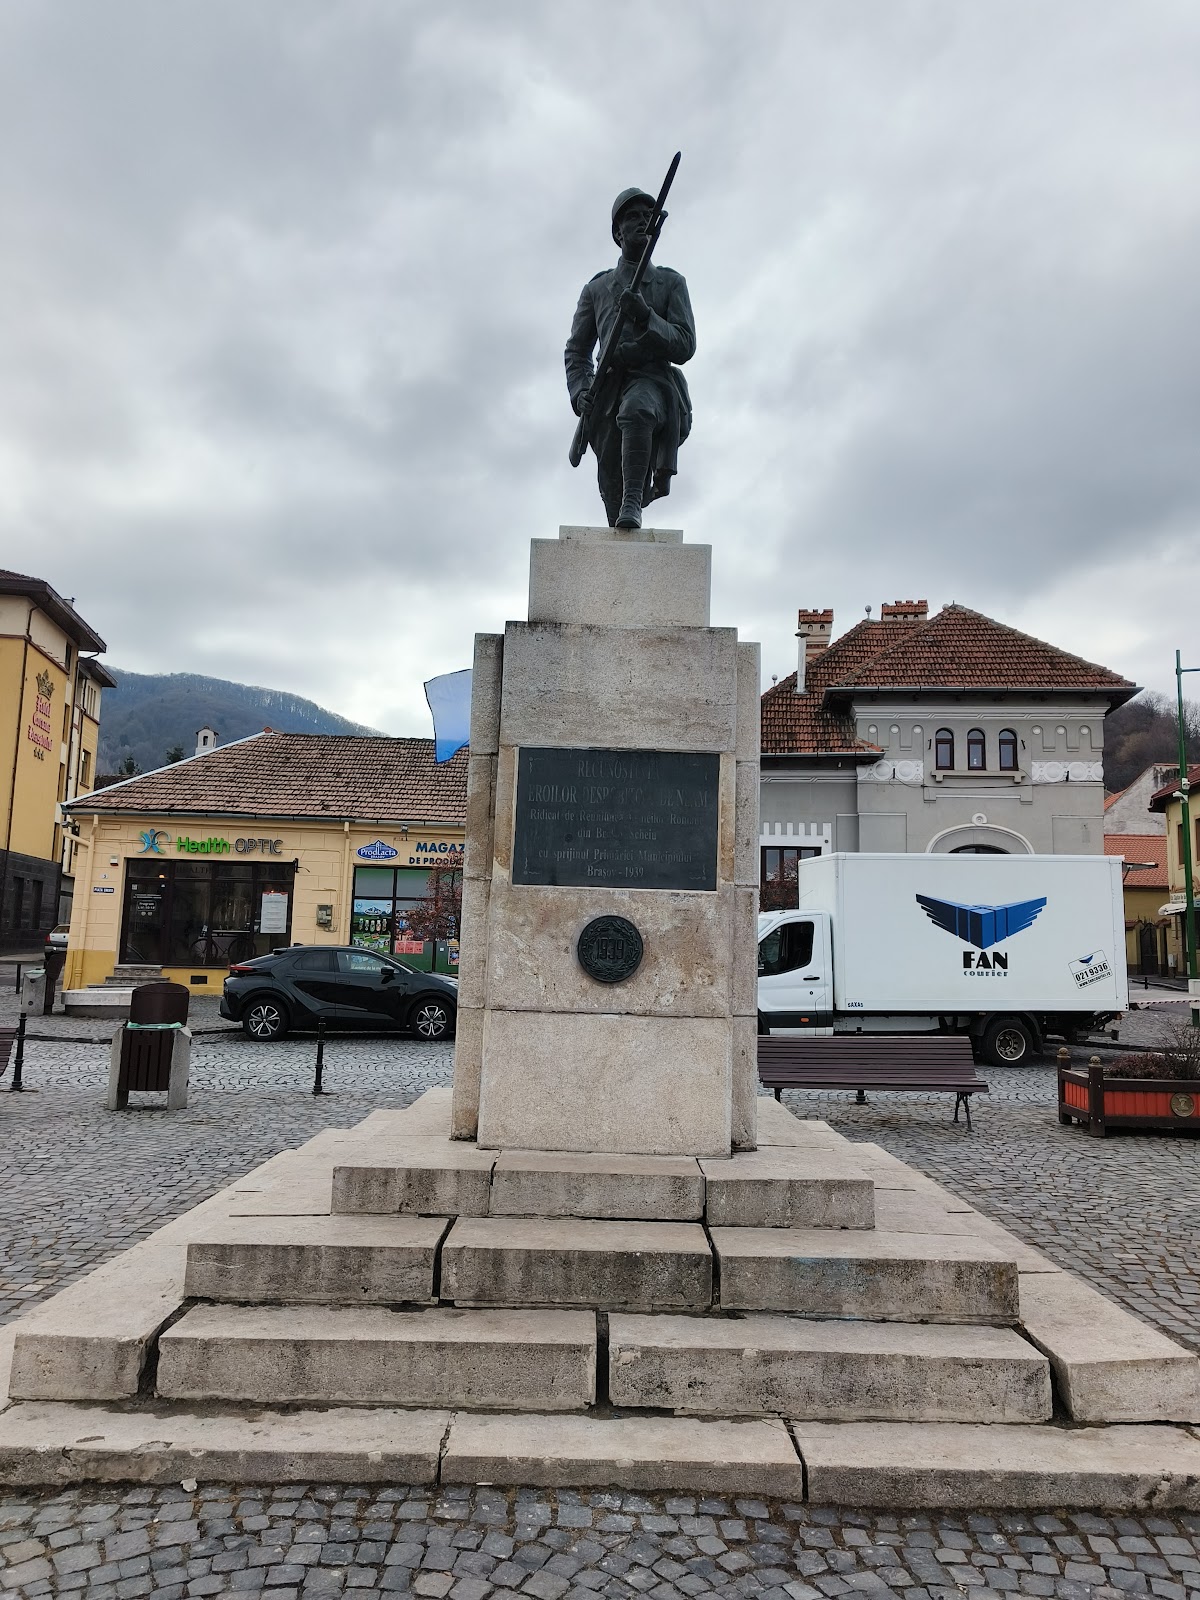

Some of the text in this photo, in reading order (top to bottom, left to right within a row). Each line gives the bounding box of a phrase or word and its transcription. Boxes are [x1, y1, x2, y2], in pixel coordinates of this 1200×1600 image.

[528, 784, 577, 803] EROILOR
[530, 809, 560, 821] Ridicat
[564, 810, 575, 821] de
[577, 827, 591, 838] din
[177, 837, 283, 855] Health OPTIC
[538, 849, 548, 858] cu
[553, 848, 589, 862] sprijinul
[625, 866, 644, 878] 1939
[963, 951, 1008, 969] FAN
[1075, 962, 1108, 982] 021 9336
